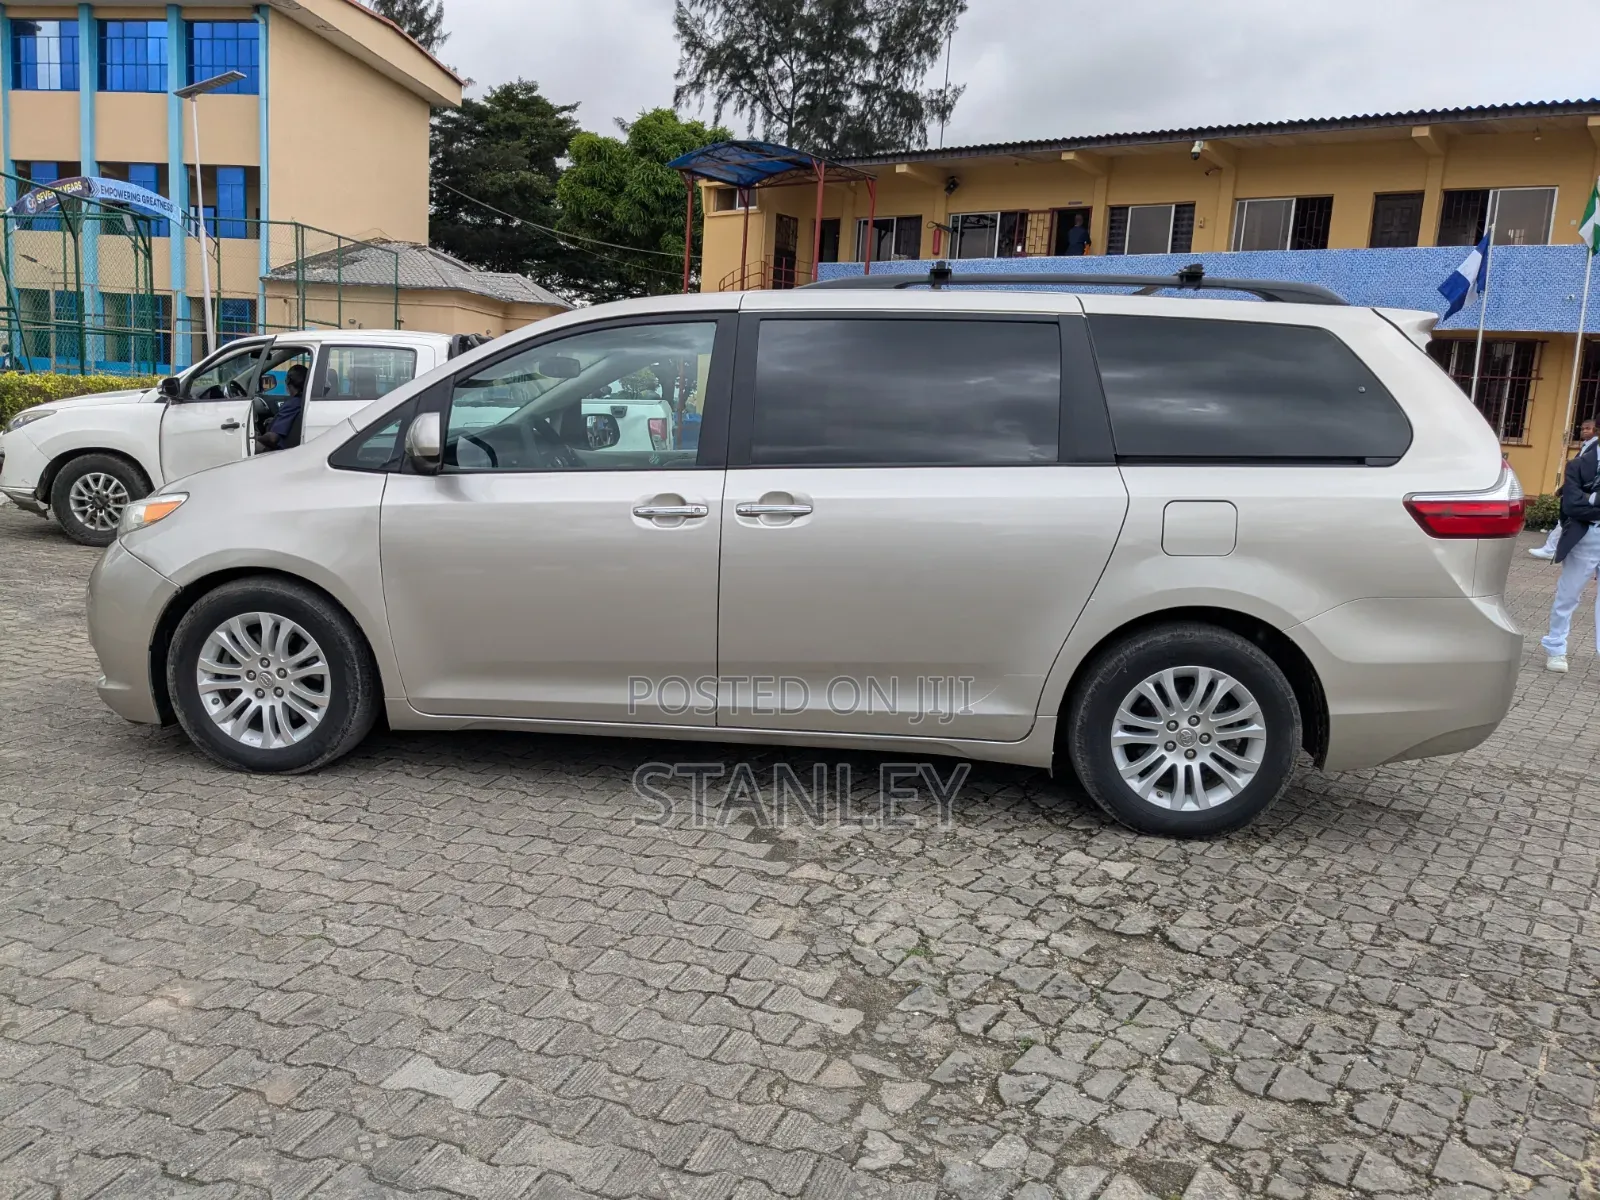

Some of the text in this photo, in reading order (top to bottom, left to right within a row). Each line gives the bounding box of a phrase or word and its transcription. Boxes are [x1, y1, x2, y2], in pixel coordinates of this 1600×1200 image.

[62, 181, 83, 194] YEARS
[100, 186, 174, 213] EMPOWERING GREATNESS
